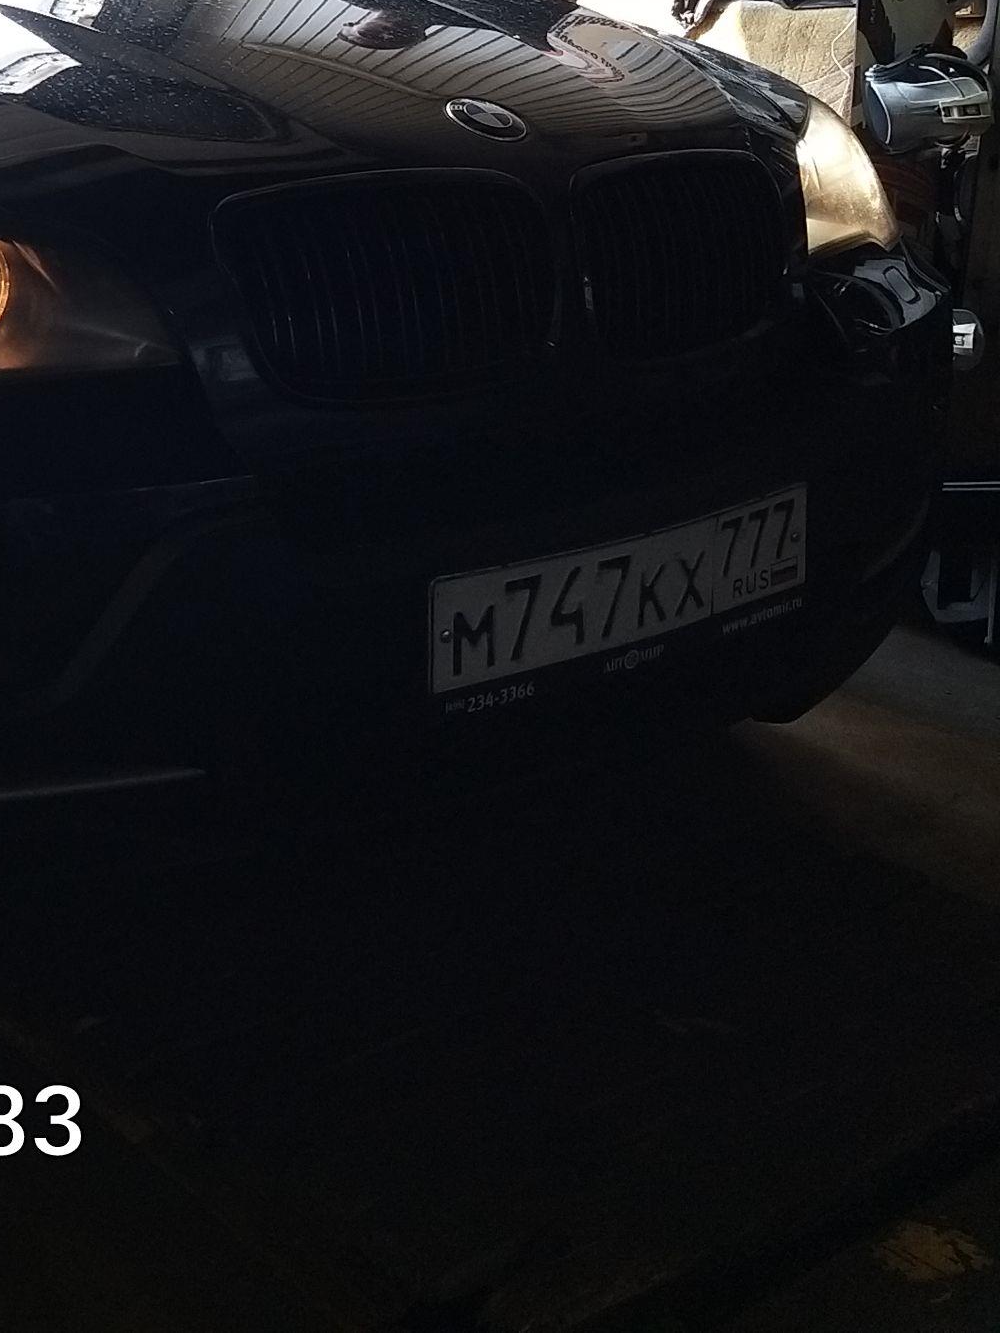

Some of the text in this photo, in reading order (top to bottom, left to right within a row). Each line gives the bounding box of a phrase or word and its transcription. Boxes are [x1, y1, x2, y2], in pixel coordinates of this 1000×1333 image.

[720, 497, 796, 578] 777
[732, 567, 770, 599] RUS
[466, 681, 536, 713] 234-3366
